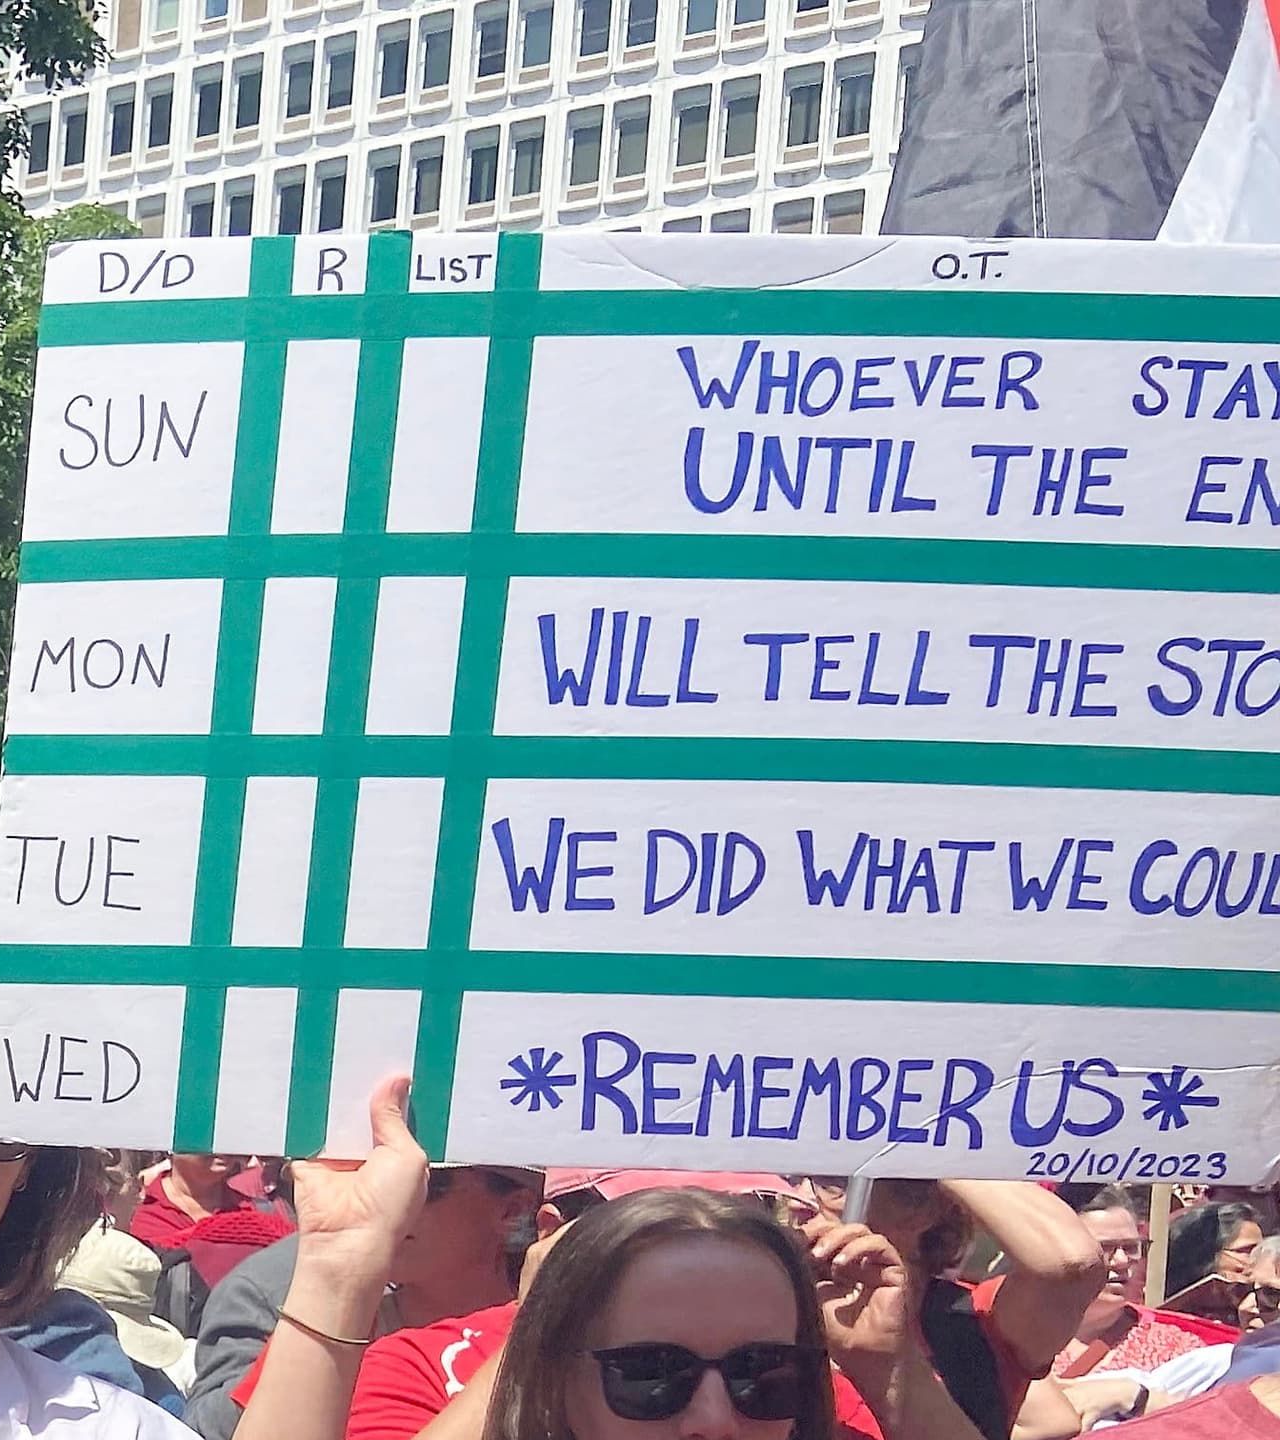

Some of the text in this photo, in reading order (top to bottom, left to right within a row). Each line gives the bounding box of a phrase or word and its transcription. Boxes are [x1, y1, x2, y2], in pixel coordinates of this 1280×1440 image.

[99, 252, 194, 294] D/D
[316, 247, 348, 292] R
[415, 253, 493, 284] LIST
[931, 251, 1009, 281] O.T.
[676, 340, 1043, 418] WHOEVER
[59, 390, 208, 471] SUN
[683, 427, 937, 515] UNTIL
[971, 444, 1128, 517] THE
[30, 633, 171, 694] MON
[537, 607, 1280, 718] WILL TELL THE STO
[5, 834, 142, 911] TUE
[491, 817, 618, 914] WE
[644, 828, 767, 916] DID
[795, 829, 996, 915] WHAT
[1008, 837, 1114, 912] WE
[3, 1033, 141, 1104] WED
[1026, 1146, 1228, 1183] 20/10/2023
